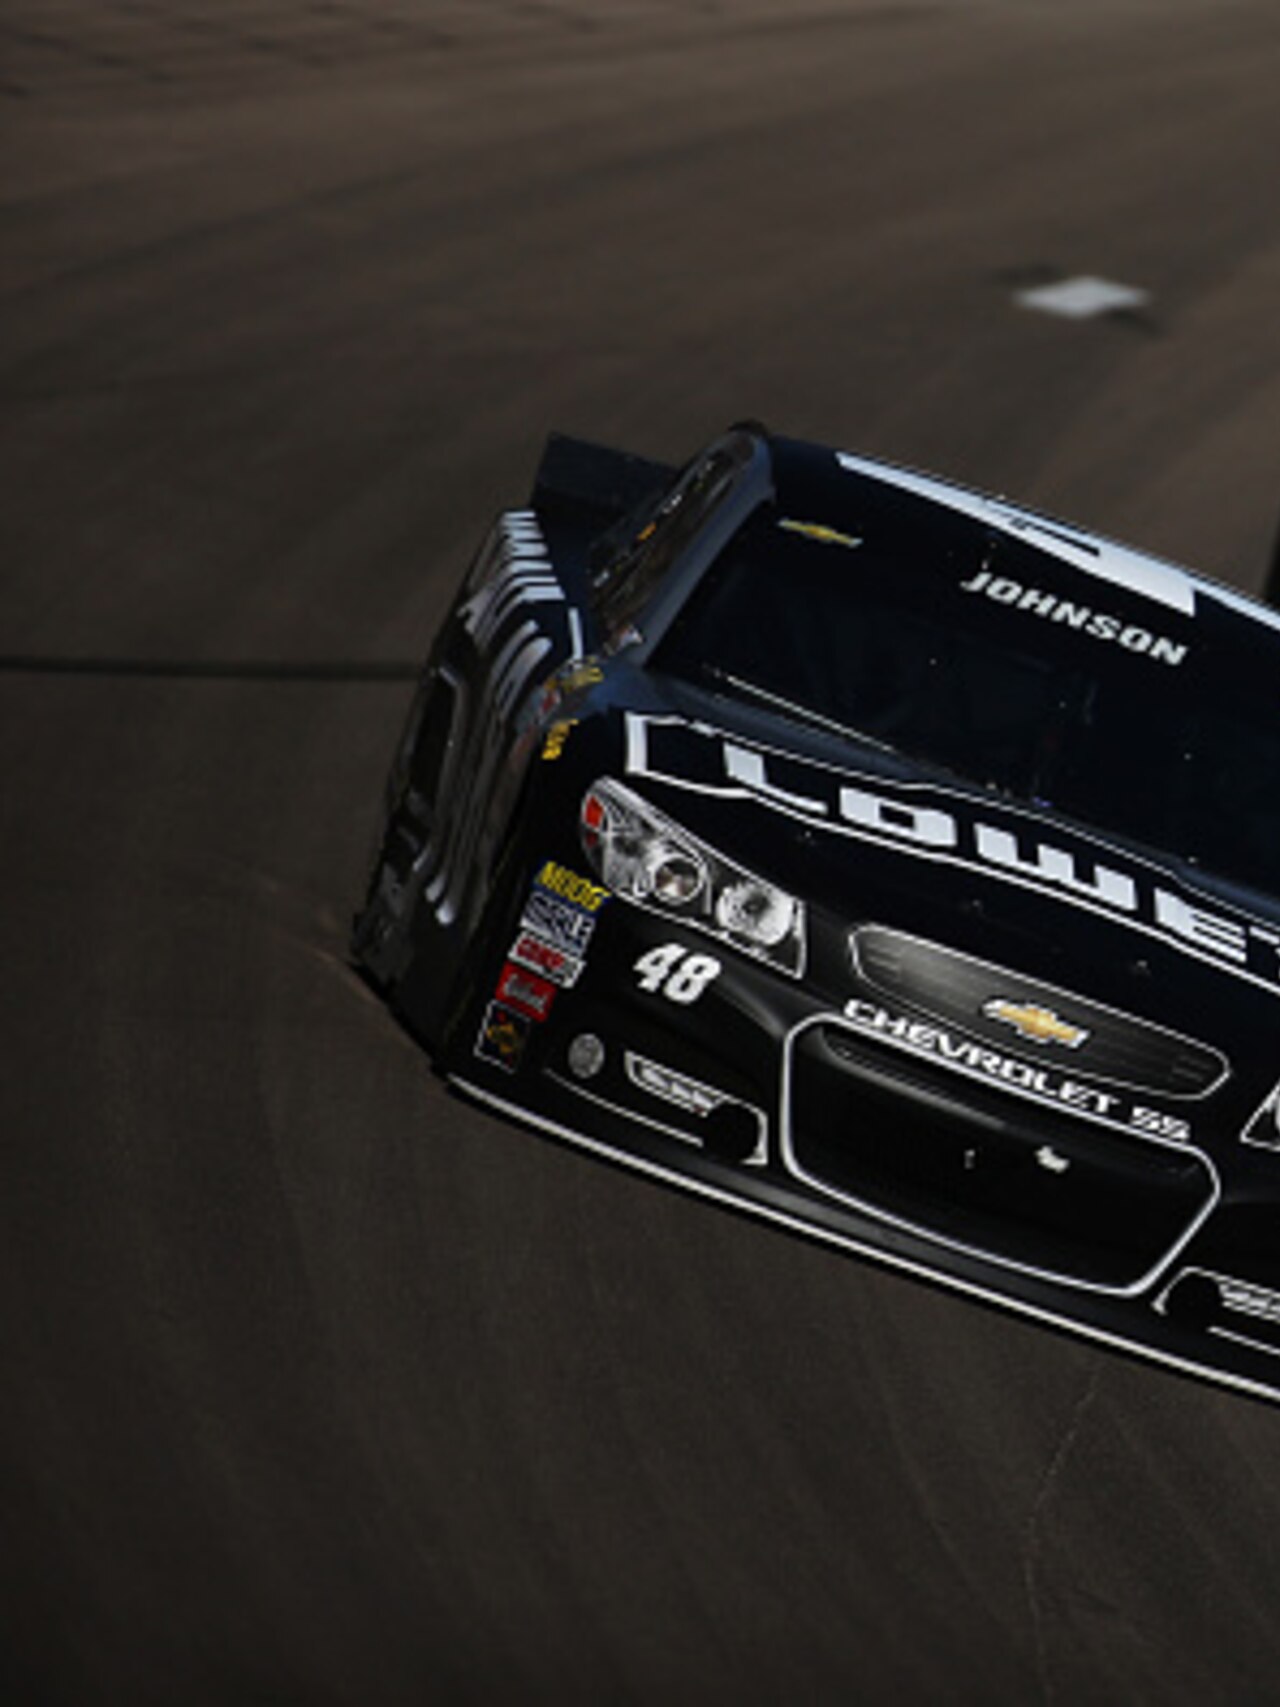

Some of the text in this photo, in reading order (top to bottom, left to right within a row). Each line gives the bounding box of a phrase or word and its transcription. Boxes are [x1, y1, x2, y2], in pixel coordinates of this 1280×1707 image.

[961, 571, 1190, 667] JOHNSON
[633, 943, 722, 1005] 48
[843, 998, 1191, 1141] CHEVROLET SS
